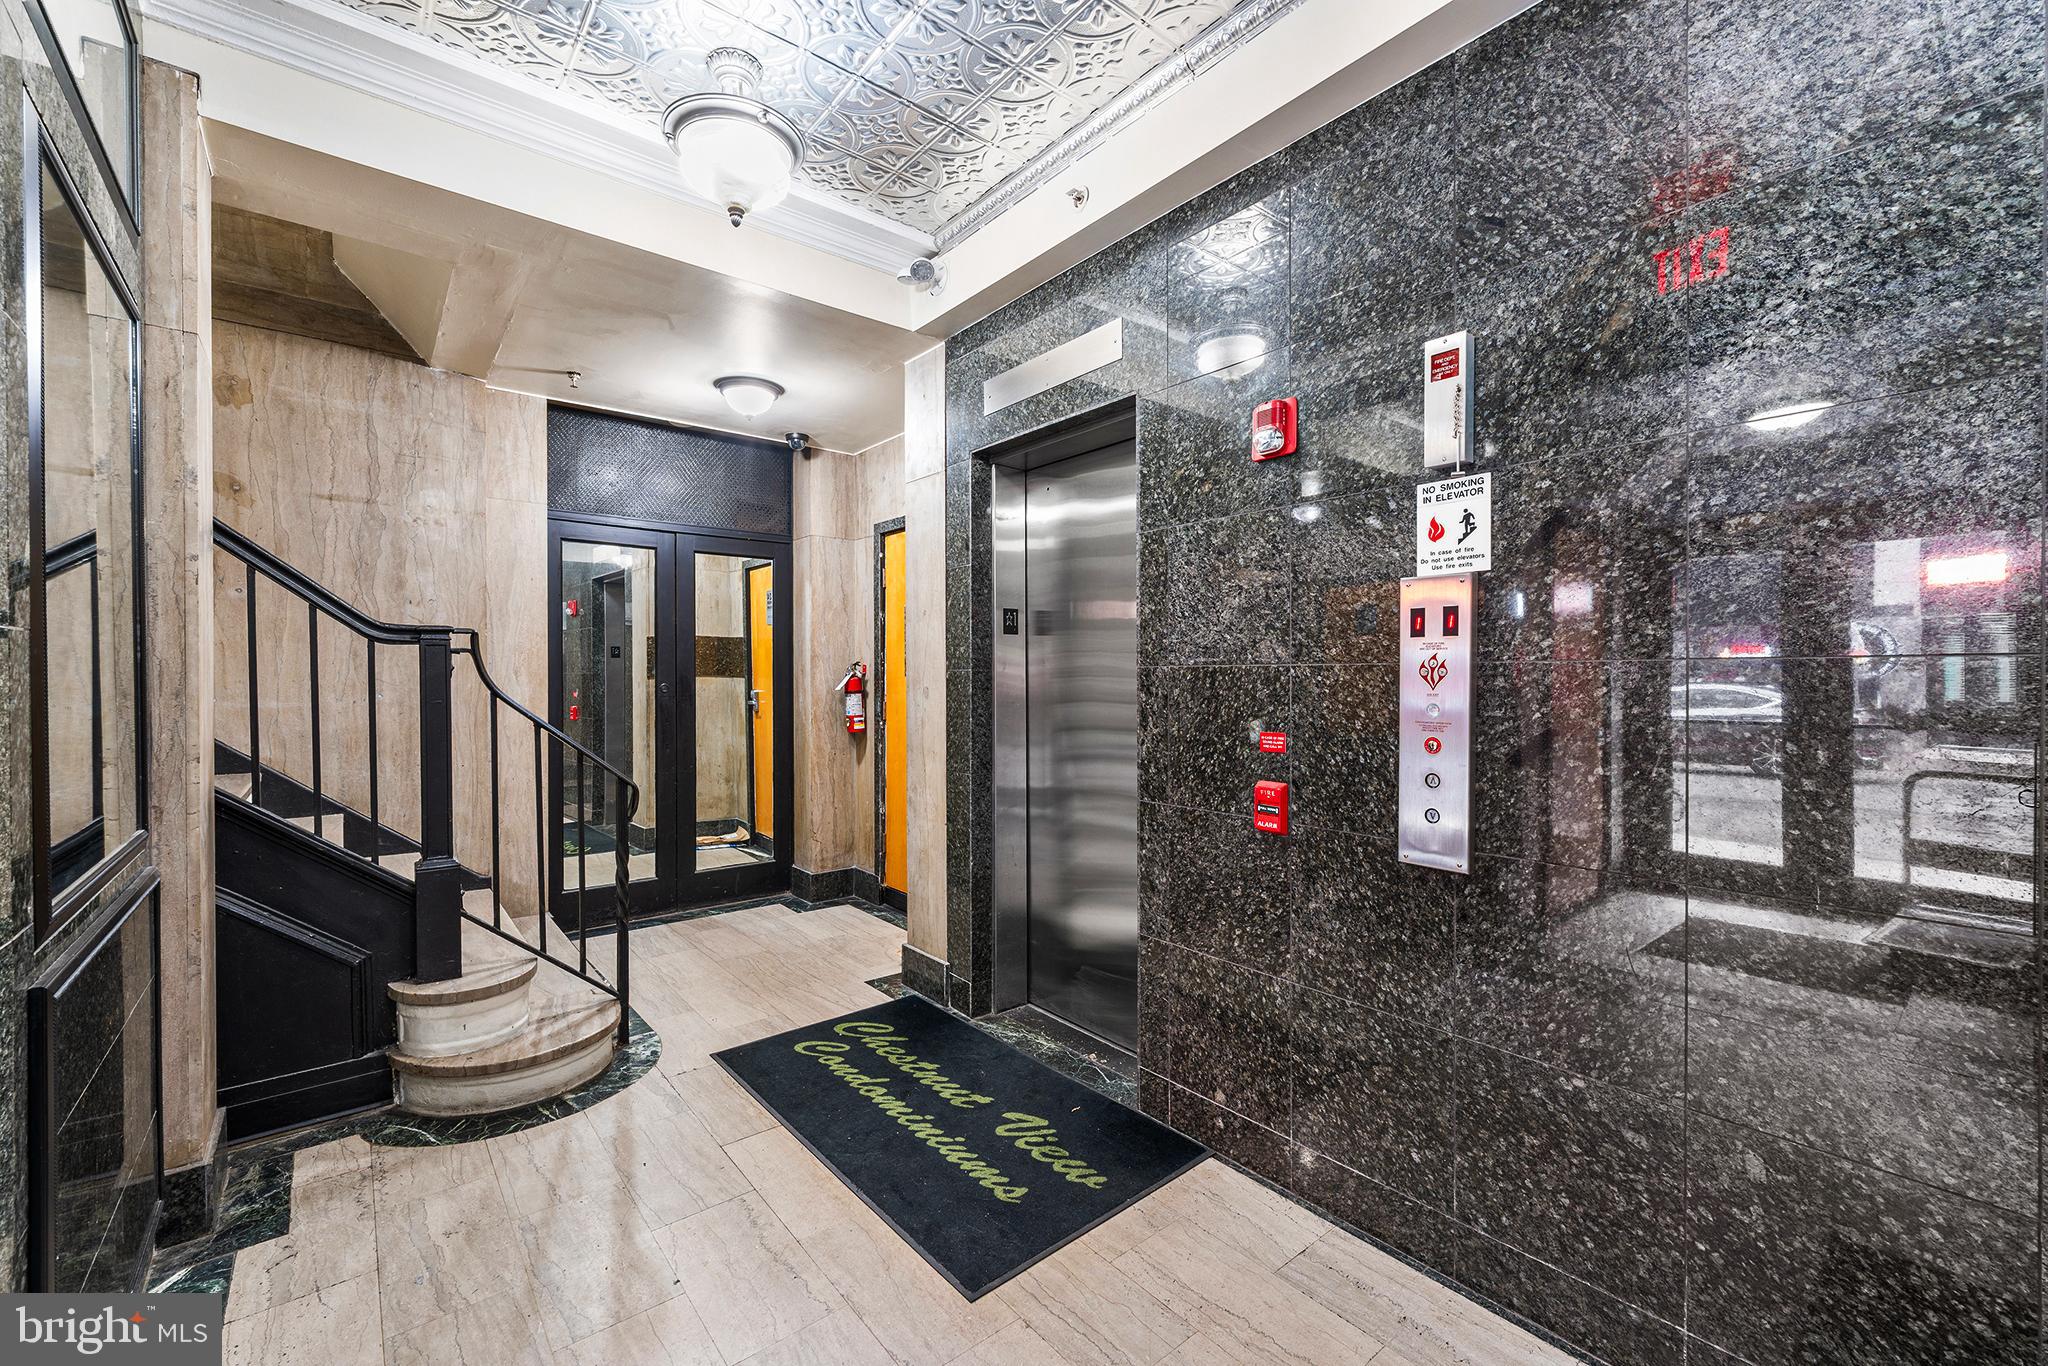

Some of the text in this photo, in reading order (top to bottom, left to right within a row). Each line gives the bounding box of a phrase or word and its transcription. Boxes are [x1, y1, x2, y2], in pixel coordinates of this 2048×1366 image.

[1422, 477, 1485, 495] NO SMOKING
[1423, 487, 1484, 504] IN ELEVATOR
[1260, 789, 1276, 797] FIRE
[1257, 820, 1278, 829] ALARM
[833, 1022, 1108, 1189] Chestnut View
[794, 1041, 1029, 1204] Condominiums
